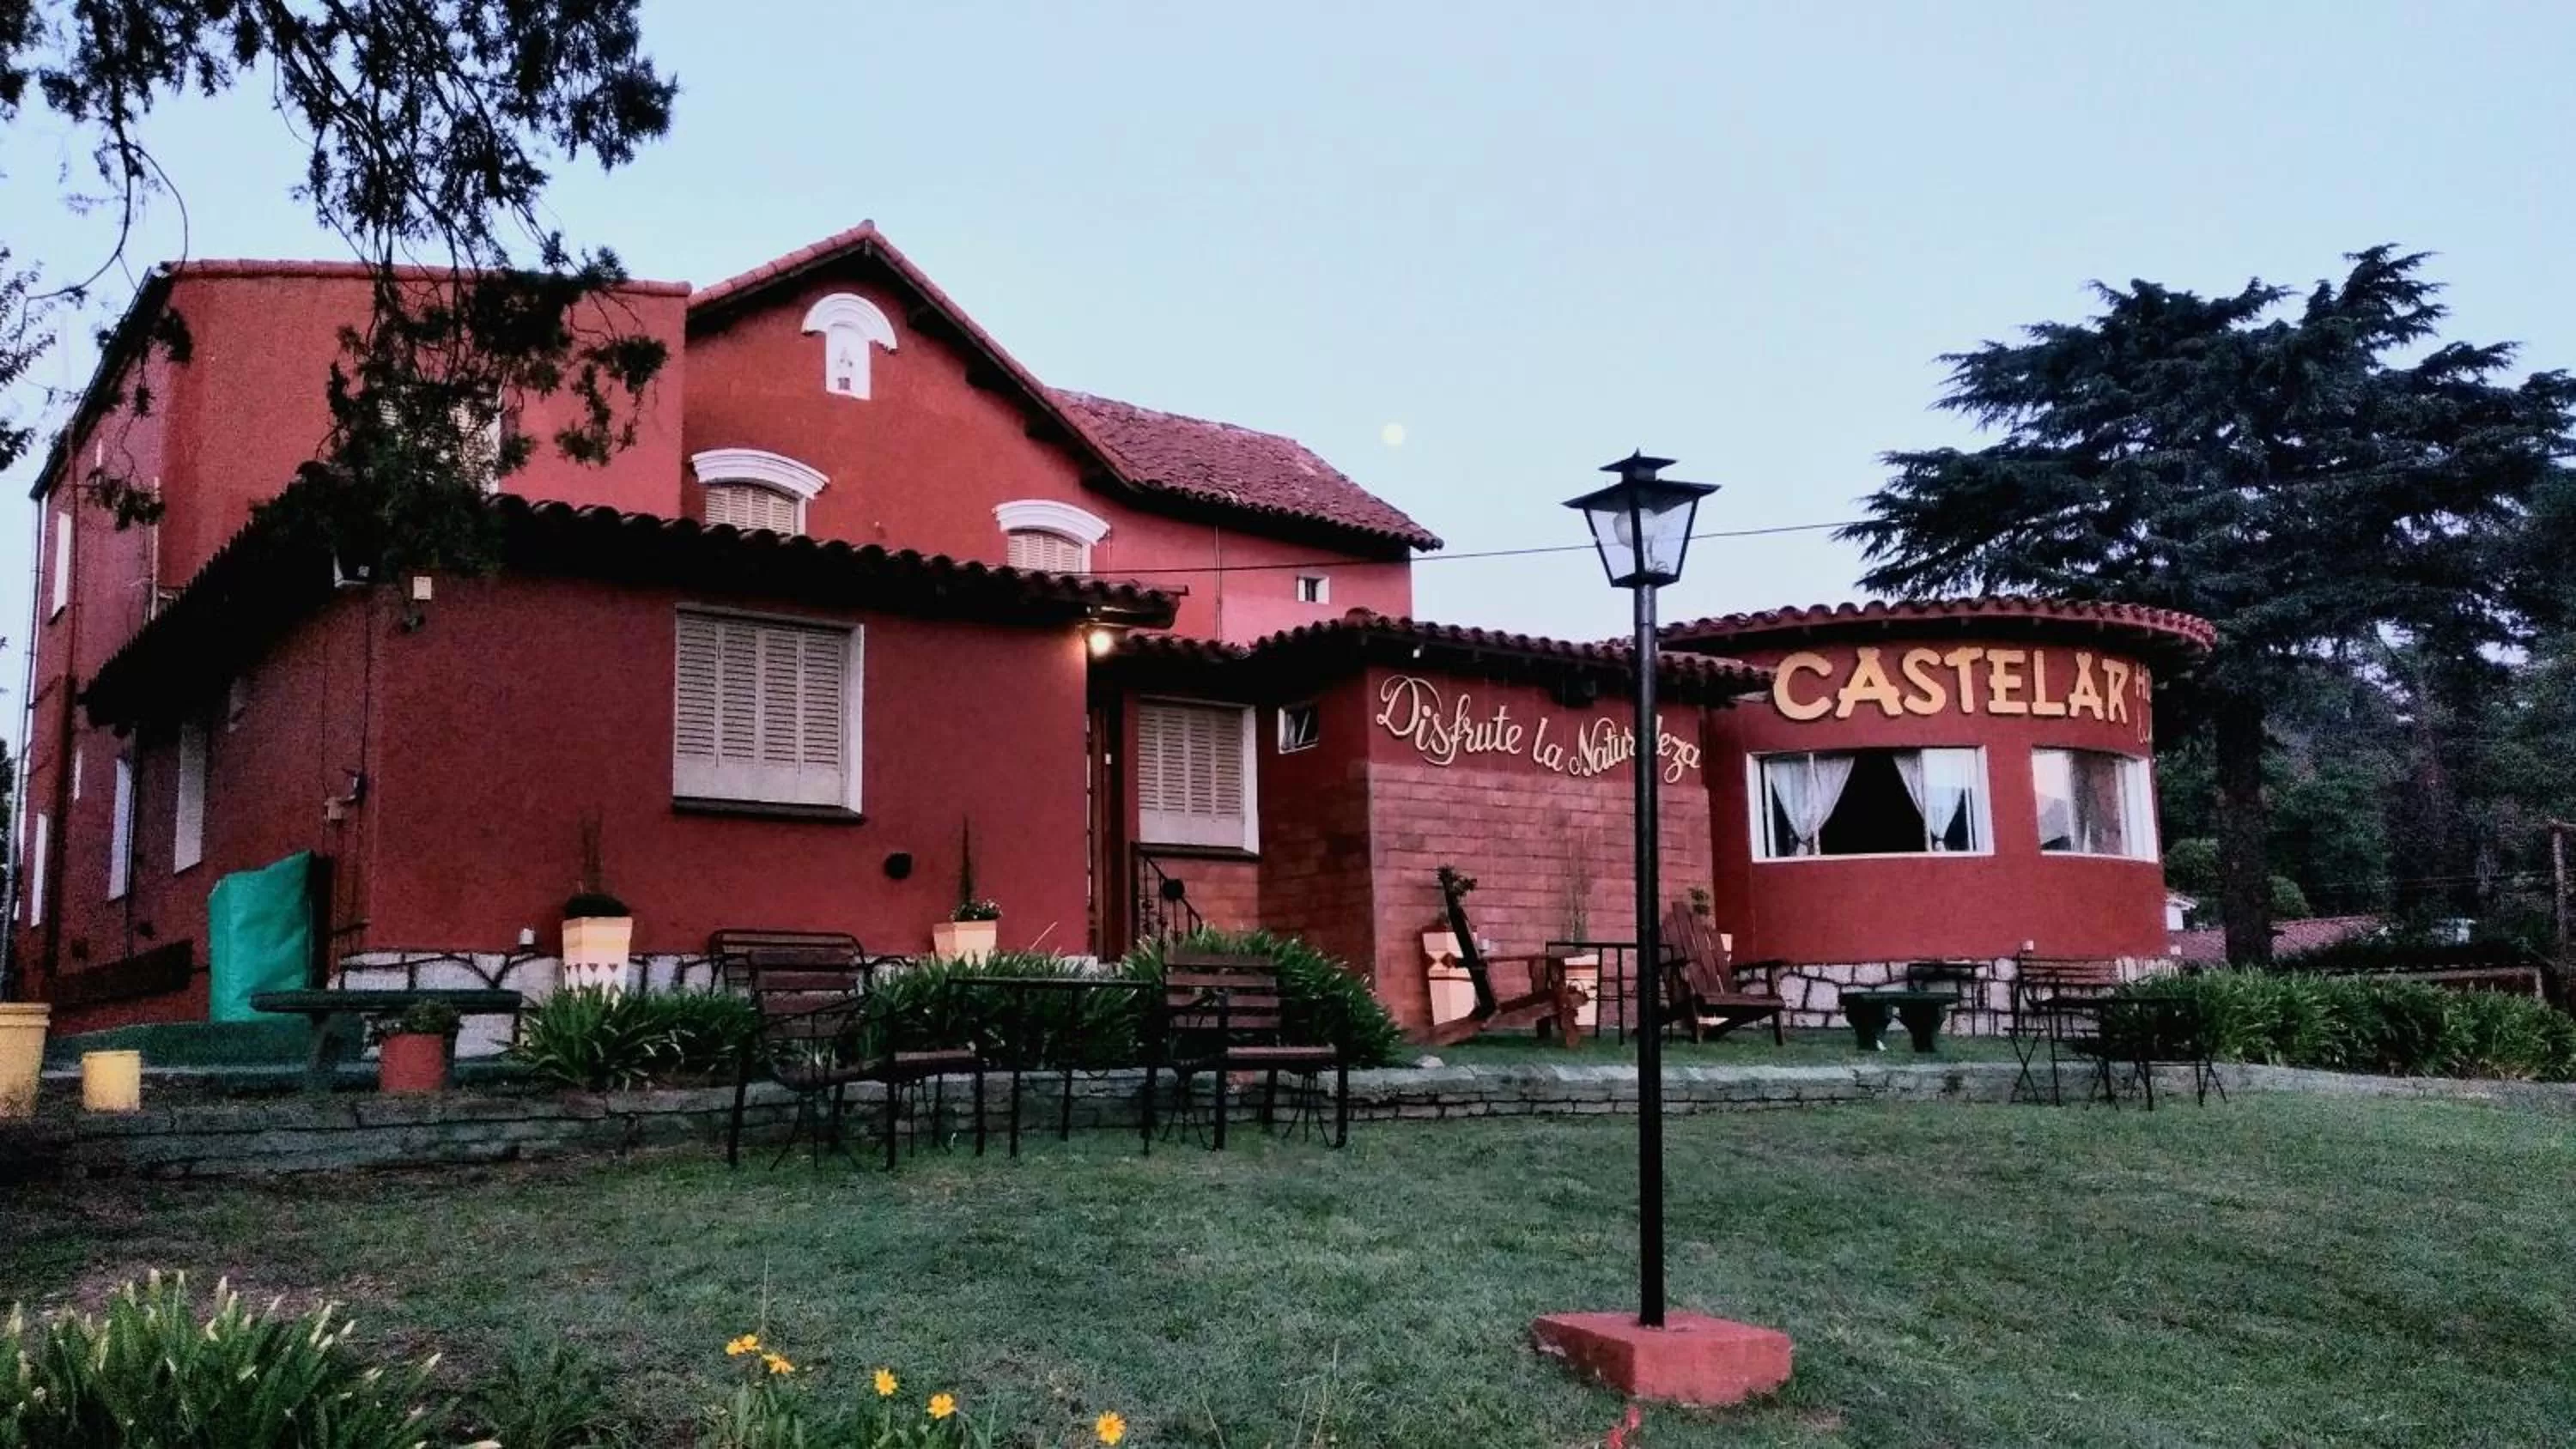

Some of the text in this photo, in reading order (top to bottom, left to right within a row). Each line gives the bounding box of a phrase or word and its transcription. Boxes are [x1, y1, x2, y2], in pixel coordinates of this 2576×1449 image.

[1376, 675, 1700, 784] Disfrute la Naturleza
[1773, 646, 2129, 724] CASTELAR
